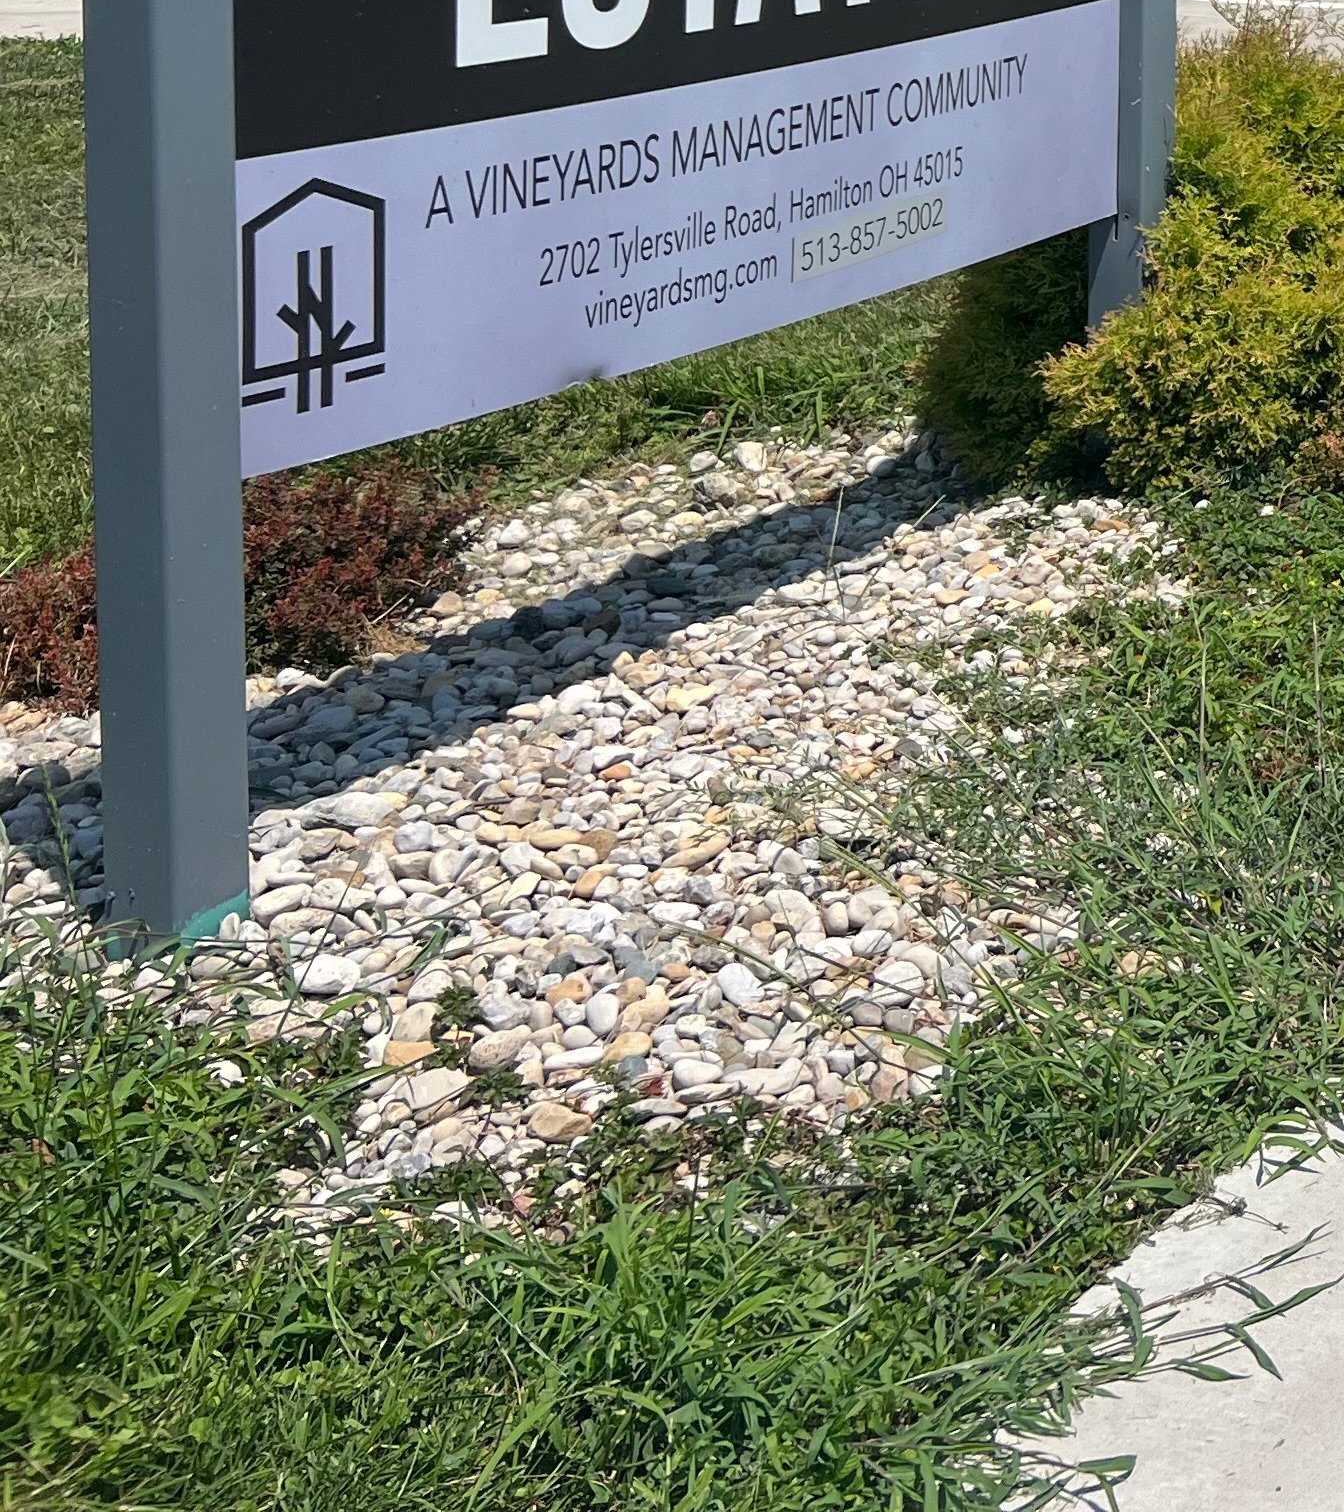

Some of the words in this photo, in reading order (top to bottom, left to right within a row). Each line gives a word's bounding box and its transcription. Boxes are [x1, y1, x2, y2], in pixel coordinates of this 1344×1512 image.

[425, 175, 454, 229] A
[465, 133, 660, 219] VINEYARDS
[671, 88, 880, 178] MANAGEMENT
[886, 53, 1028, 127] COMMUNITY
[539, 237, 600, 287] 2702
[608, 210, 716, 279] Tylersville
[724, 192, 782, 241] Road,
[790, 175, 873, 224] Hamilton
[879, 160, 908, 198] OH
[913, 145, 964, 188] 45015
[585, 254, 778, 329] vineyardsmg.com
[800, 198, 944, 272] 513-857-5002
